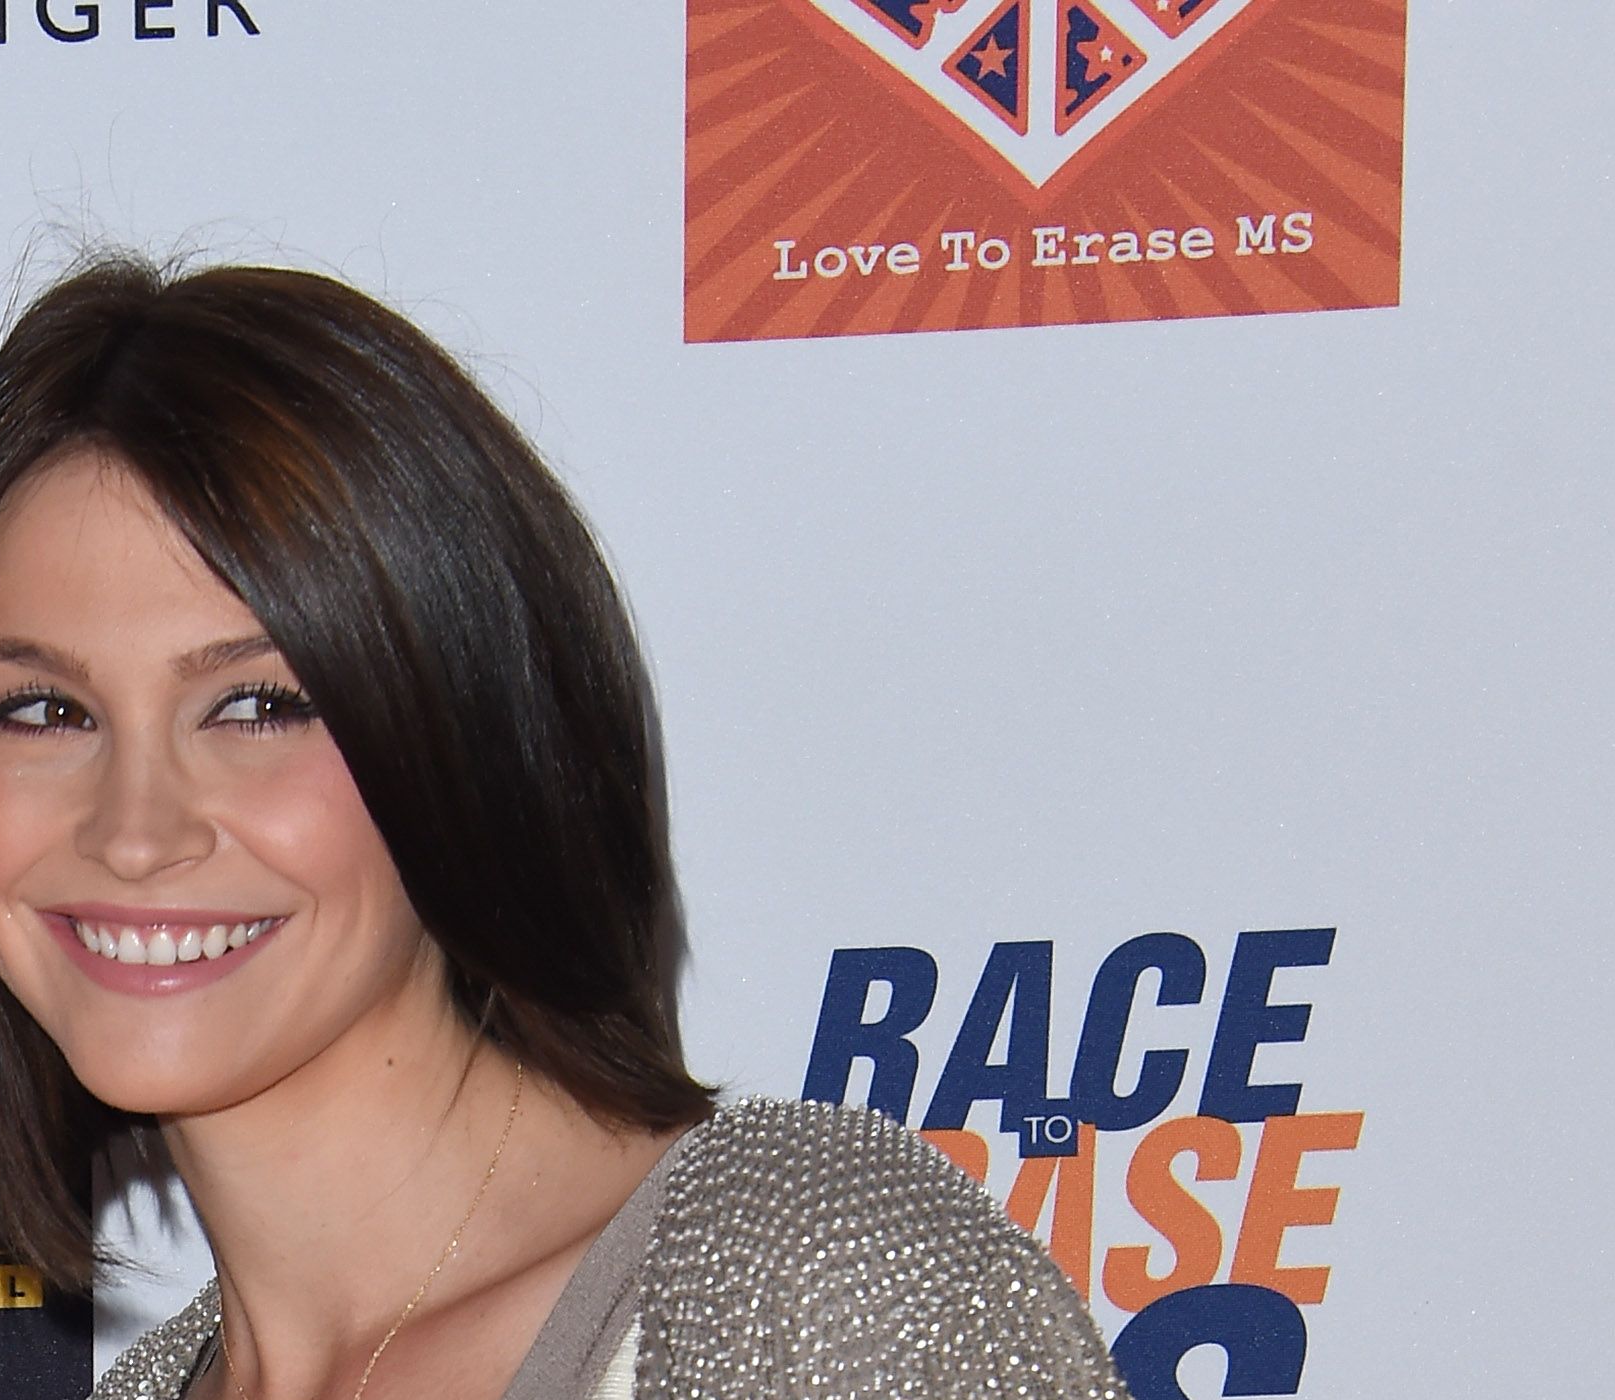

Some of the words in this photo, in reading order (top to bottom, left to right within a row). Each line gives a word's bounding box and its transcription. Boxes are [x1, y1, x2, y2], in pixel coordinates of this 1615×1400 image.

[772, 239, 920, 281] Love
[940, 231, 1011, 272] To
[1031, 225, 1214, 267] Erase
[1234, 212, 1314, 256] MS
[799, 927, 1338, 1133] RACE
[1023, 1115, 1073, 1145] TO
[911, 1112, 1366, 1314] ASE
